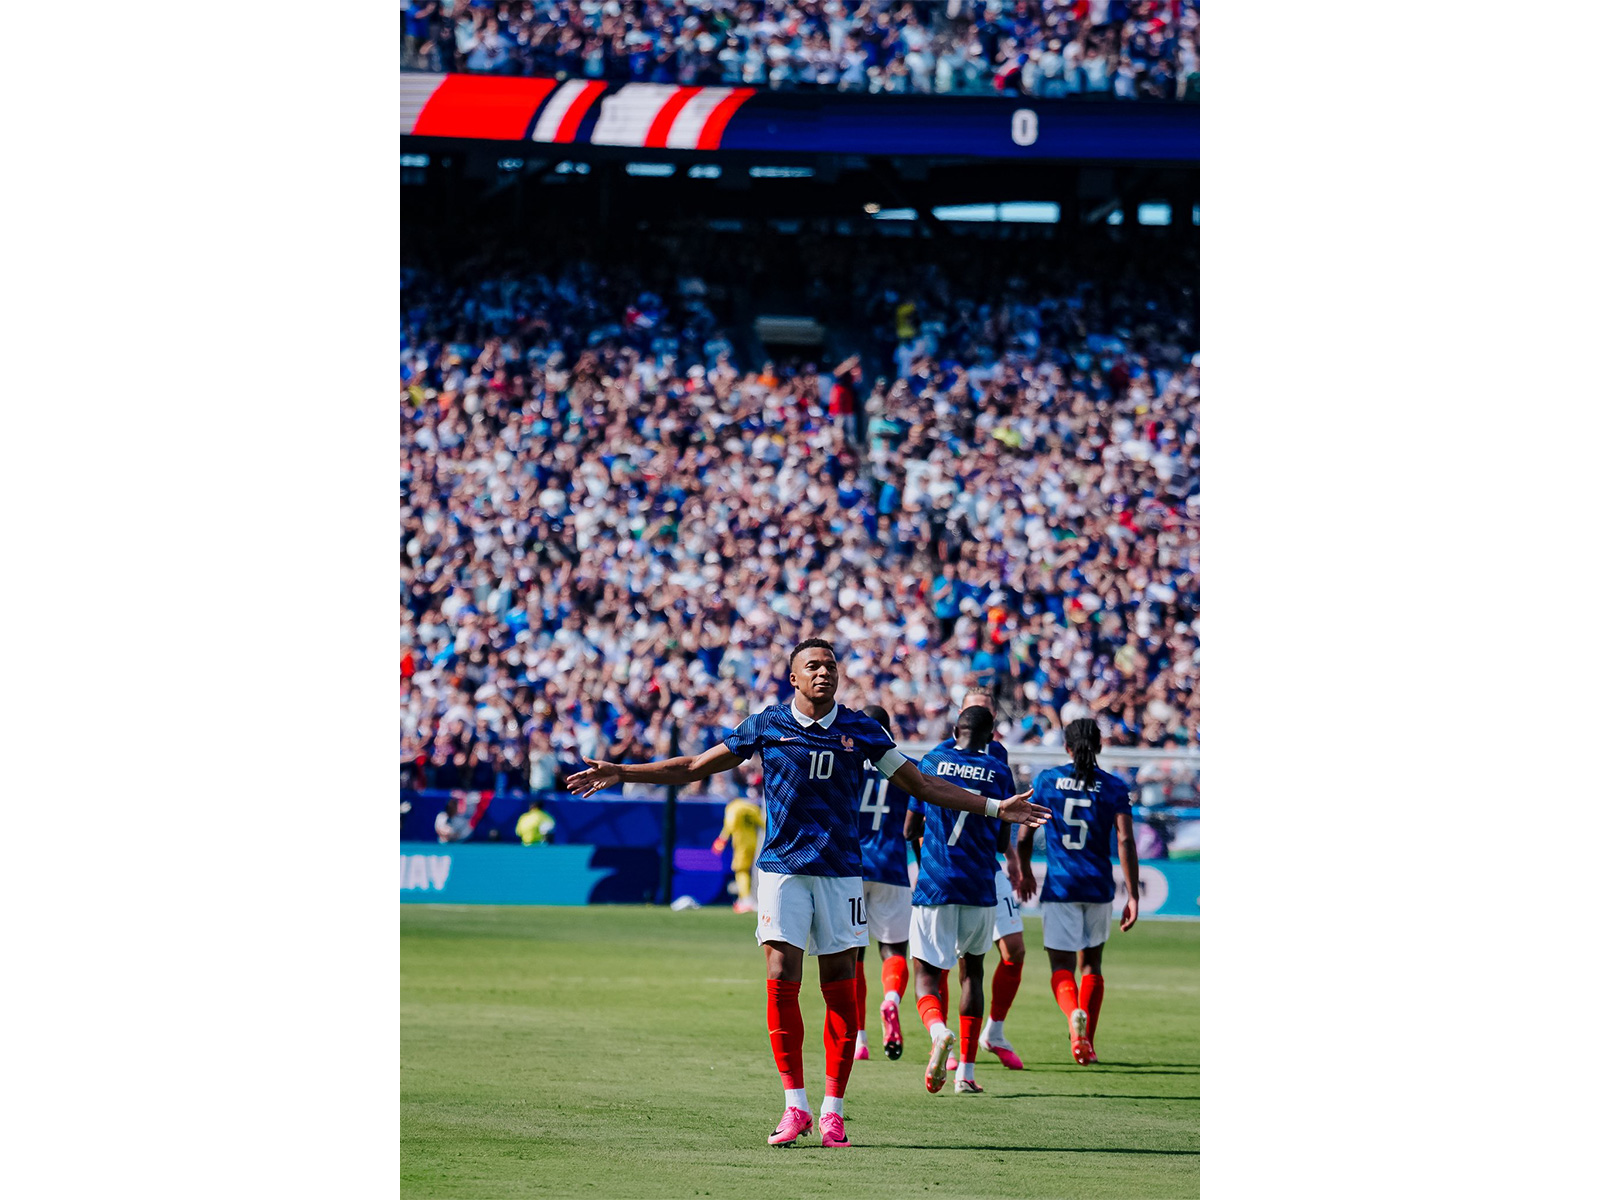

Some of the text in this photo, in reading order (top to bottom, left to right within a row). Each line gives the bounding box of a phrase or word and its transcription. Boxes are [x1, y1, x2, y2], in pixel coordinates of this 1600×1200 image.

[1012, 109, 1038, 146] 0
[809, 750, 835, 779] 10
[937, 761, 996, 783] DEMBELE
[1056, 777, 1102, 793] KOUE
[859, 778, 890, 831] 4
[947, 787, 982, 846] 7
[1062, 797, 1092, 850] 5
[848, 896, 868, 926] 10
